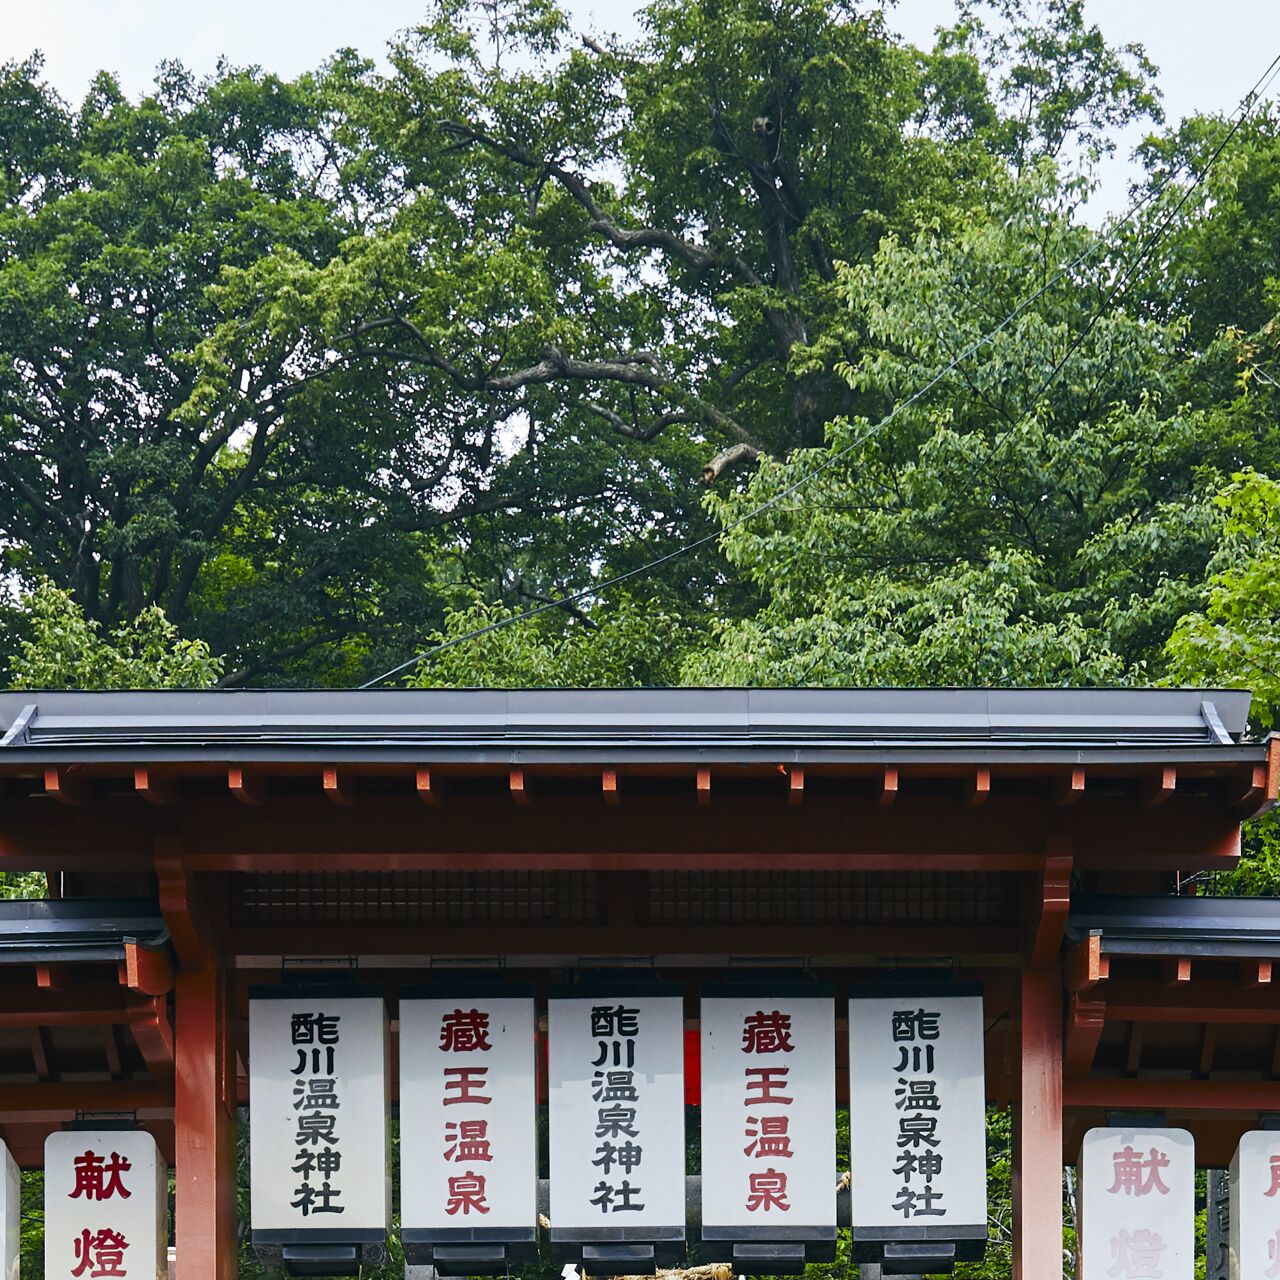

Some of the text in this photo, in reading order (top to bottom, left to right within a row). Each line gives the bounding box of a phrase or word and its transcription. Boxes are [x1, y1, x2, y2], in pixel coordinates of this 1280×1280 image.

[290, 1012, 345, 1216] 酢川温泉神社
[438, 1008, 494, 1216] 蔵王温泉
[589, 1004, 646, 1214] 酢川温泉神社
[741, 1010, 796, 1213] 蔵王温泉
[891, 1008, 947, 1218] 酢川温泉神社
[68, 1149, 132, 1279] 献燈
[1107, 1145, 1171, 1280] 献燈
